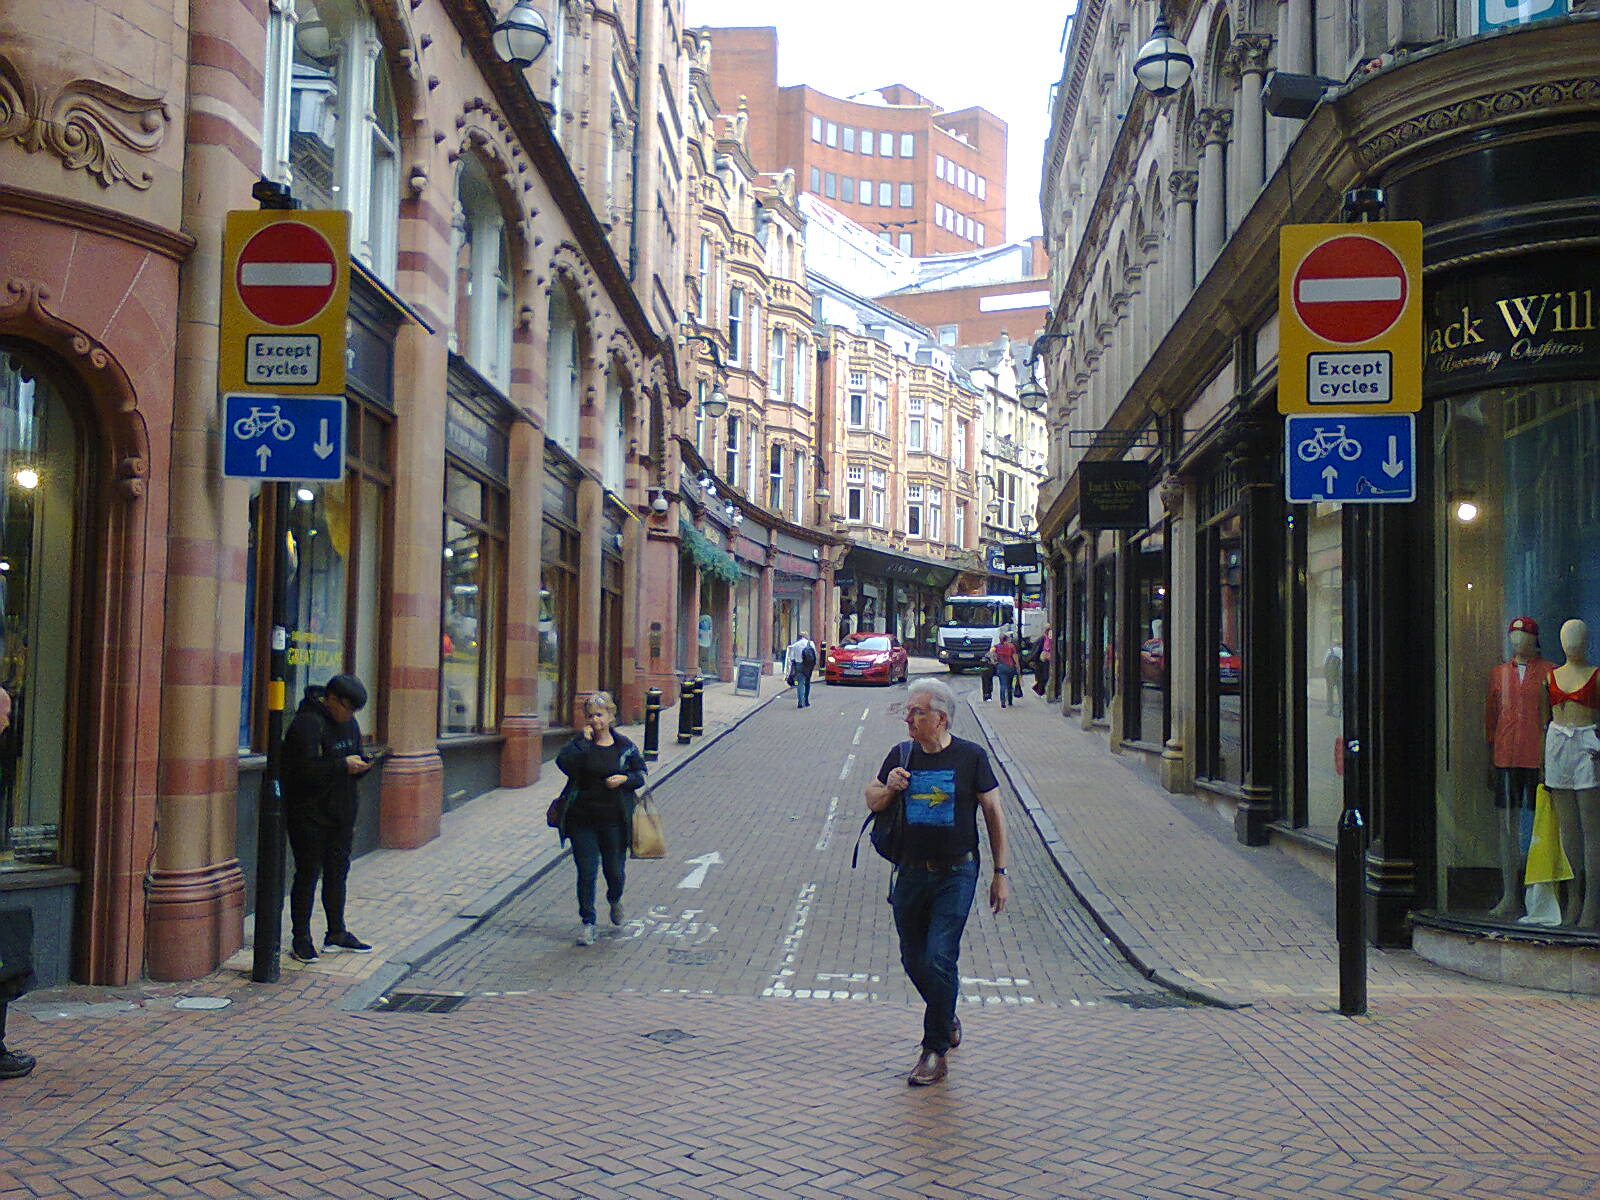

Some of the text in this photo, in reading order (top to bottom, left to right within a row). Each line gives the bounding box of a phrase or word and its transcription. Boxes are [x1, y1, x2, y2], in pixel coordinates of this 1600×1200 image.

[1430, 288, 1600, 355] ack Will
[255, 343, 311, 360] Except
[256, 362, 308, 376] cycles
[1317, 360, 1383, 379] Except
[1320, 378, 1379, 396] cycles
